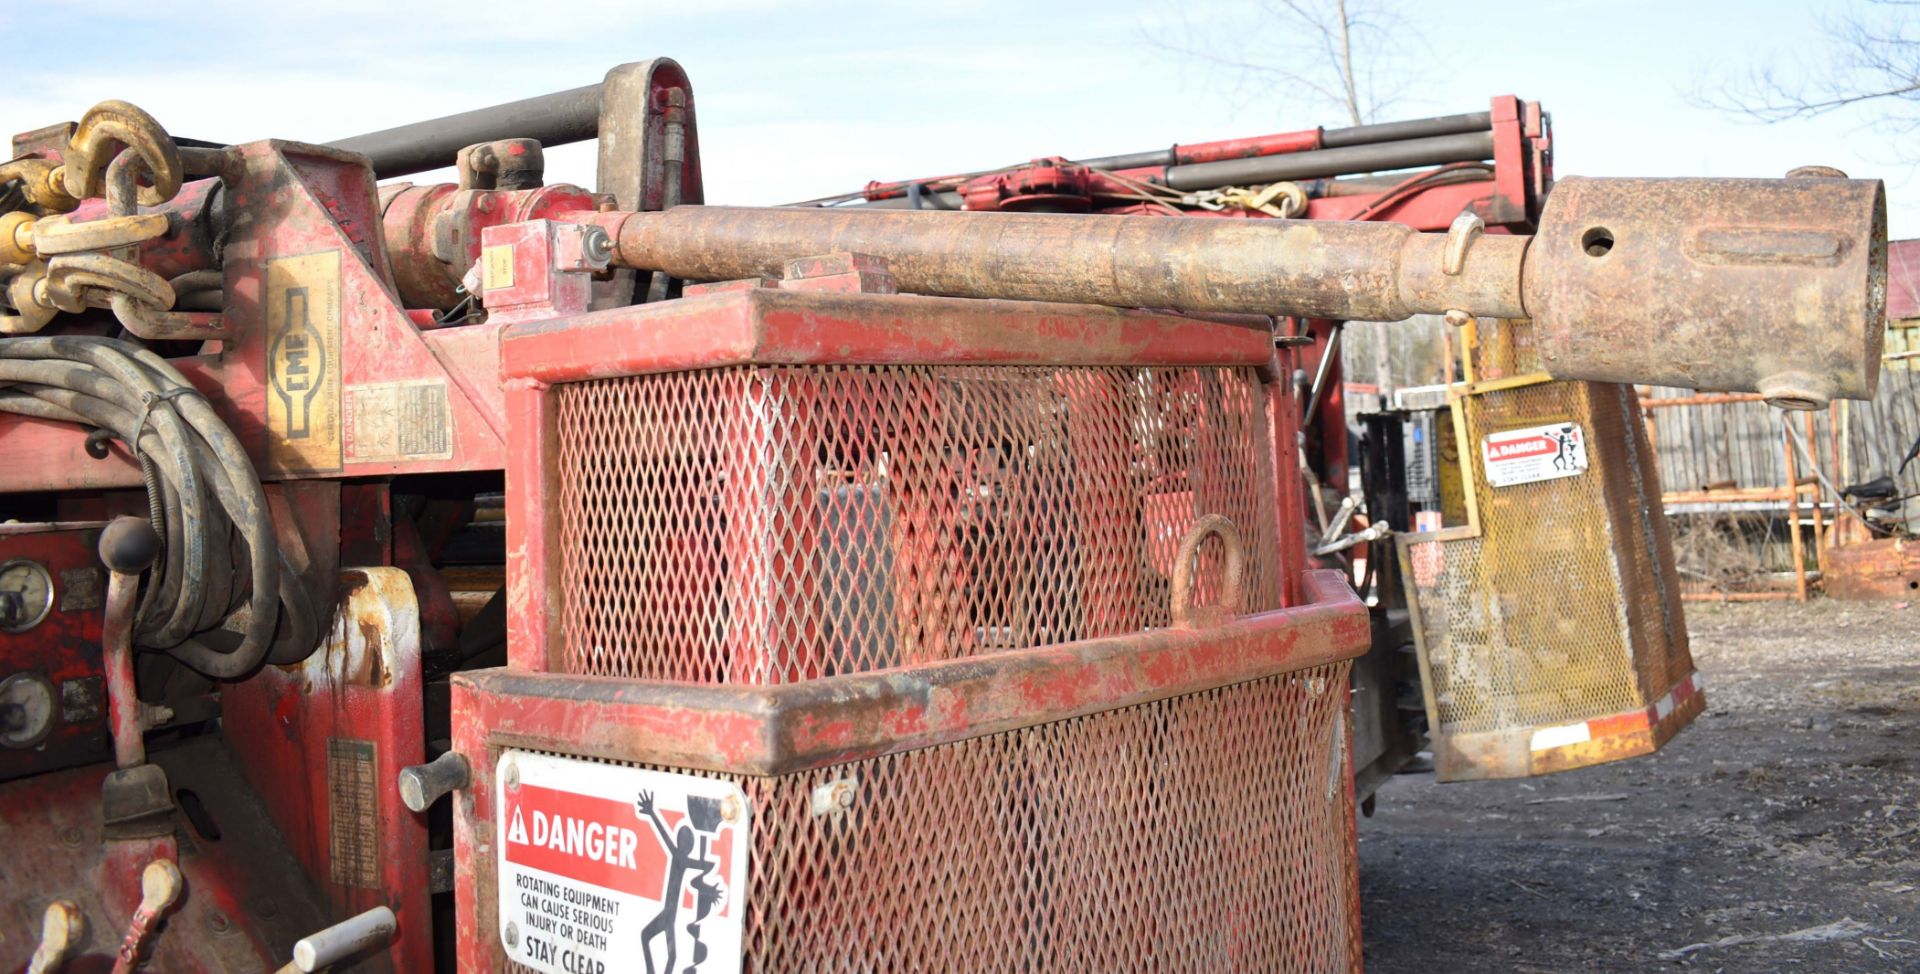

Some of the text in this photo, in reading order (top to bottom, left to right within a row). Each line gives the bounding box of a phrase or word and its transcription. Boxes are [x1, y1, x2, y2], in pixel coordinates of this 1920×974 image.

[285, 334, 310, 391] CME
[345, 393, 353, 441] DANGER
[1500, 439, 1547, 456] DANGER
[532, 809, 638, 870] DANGER
[516, 873, 620, 917] ROTATING EQUIPMENT
[521, 892, 614, 934] CAN CAUSE SERIOUS
[525, 911, 607, 952] INJURY OR DEATH
[526, 935, 606, 974] STAY CLEAR
